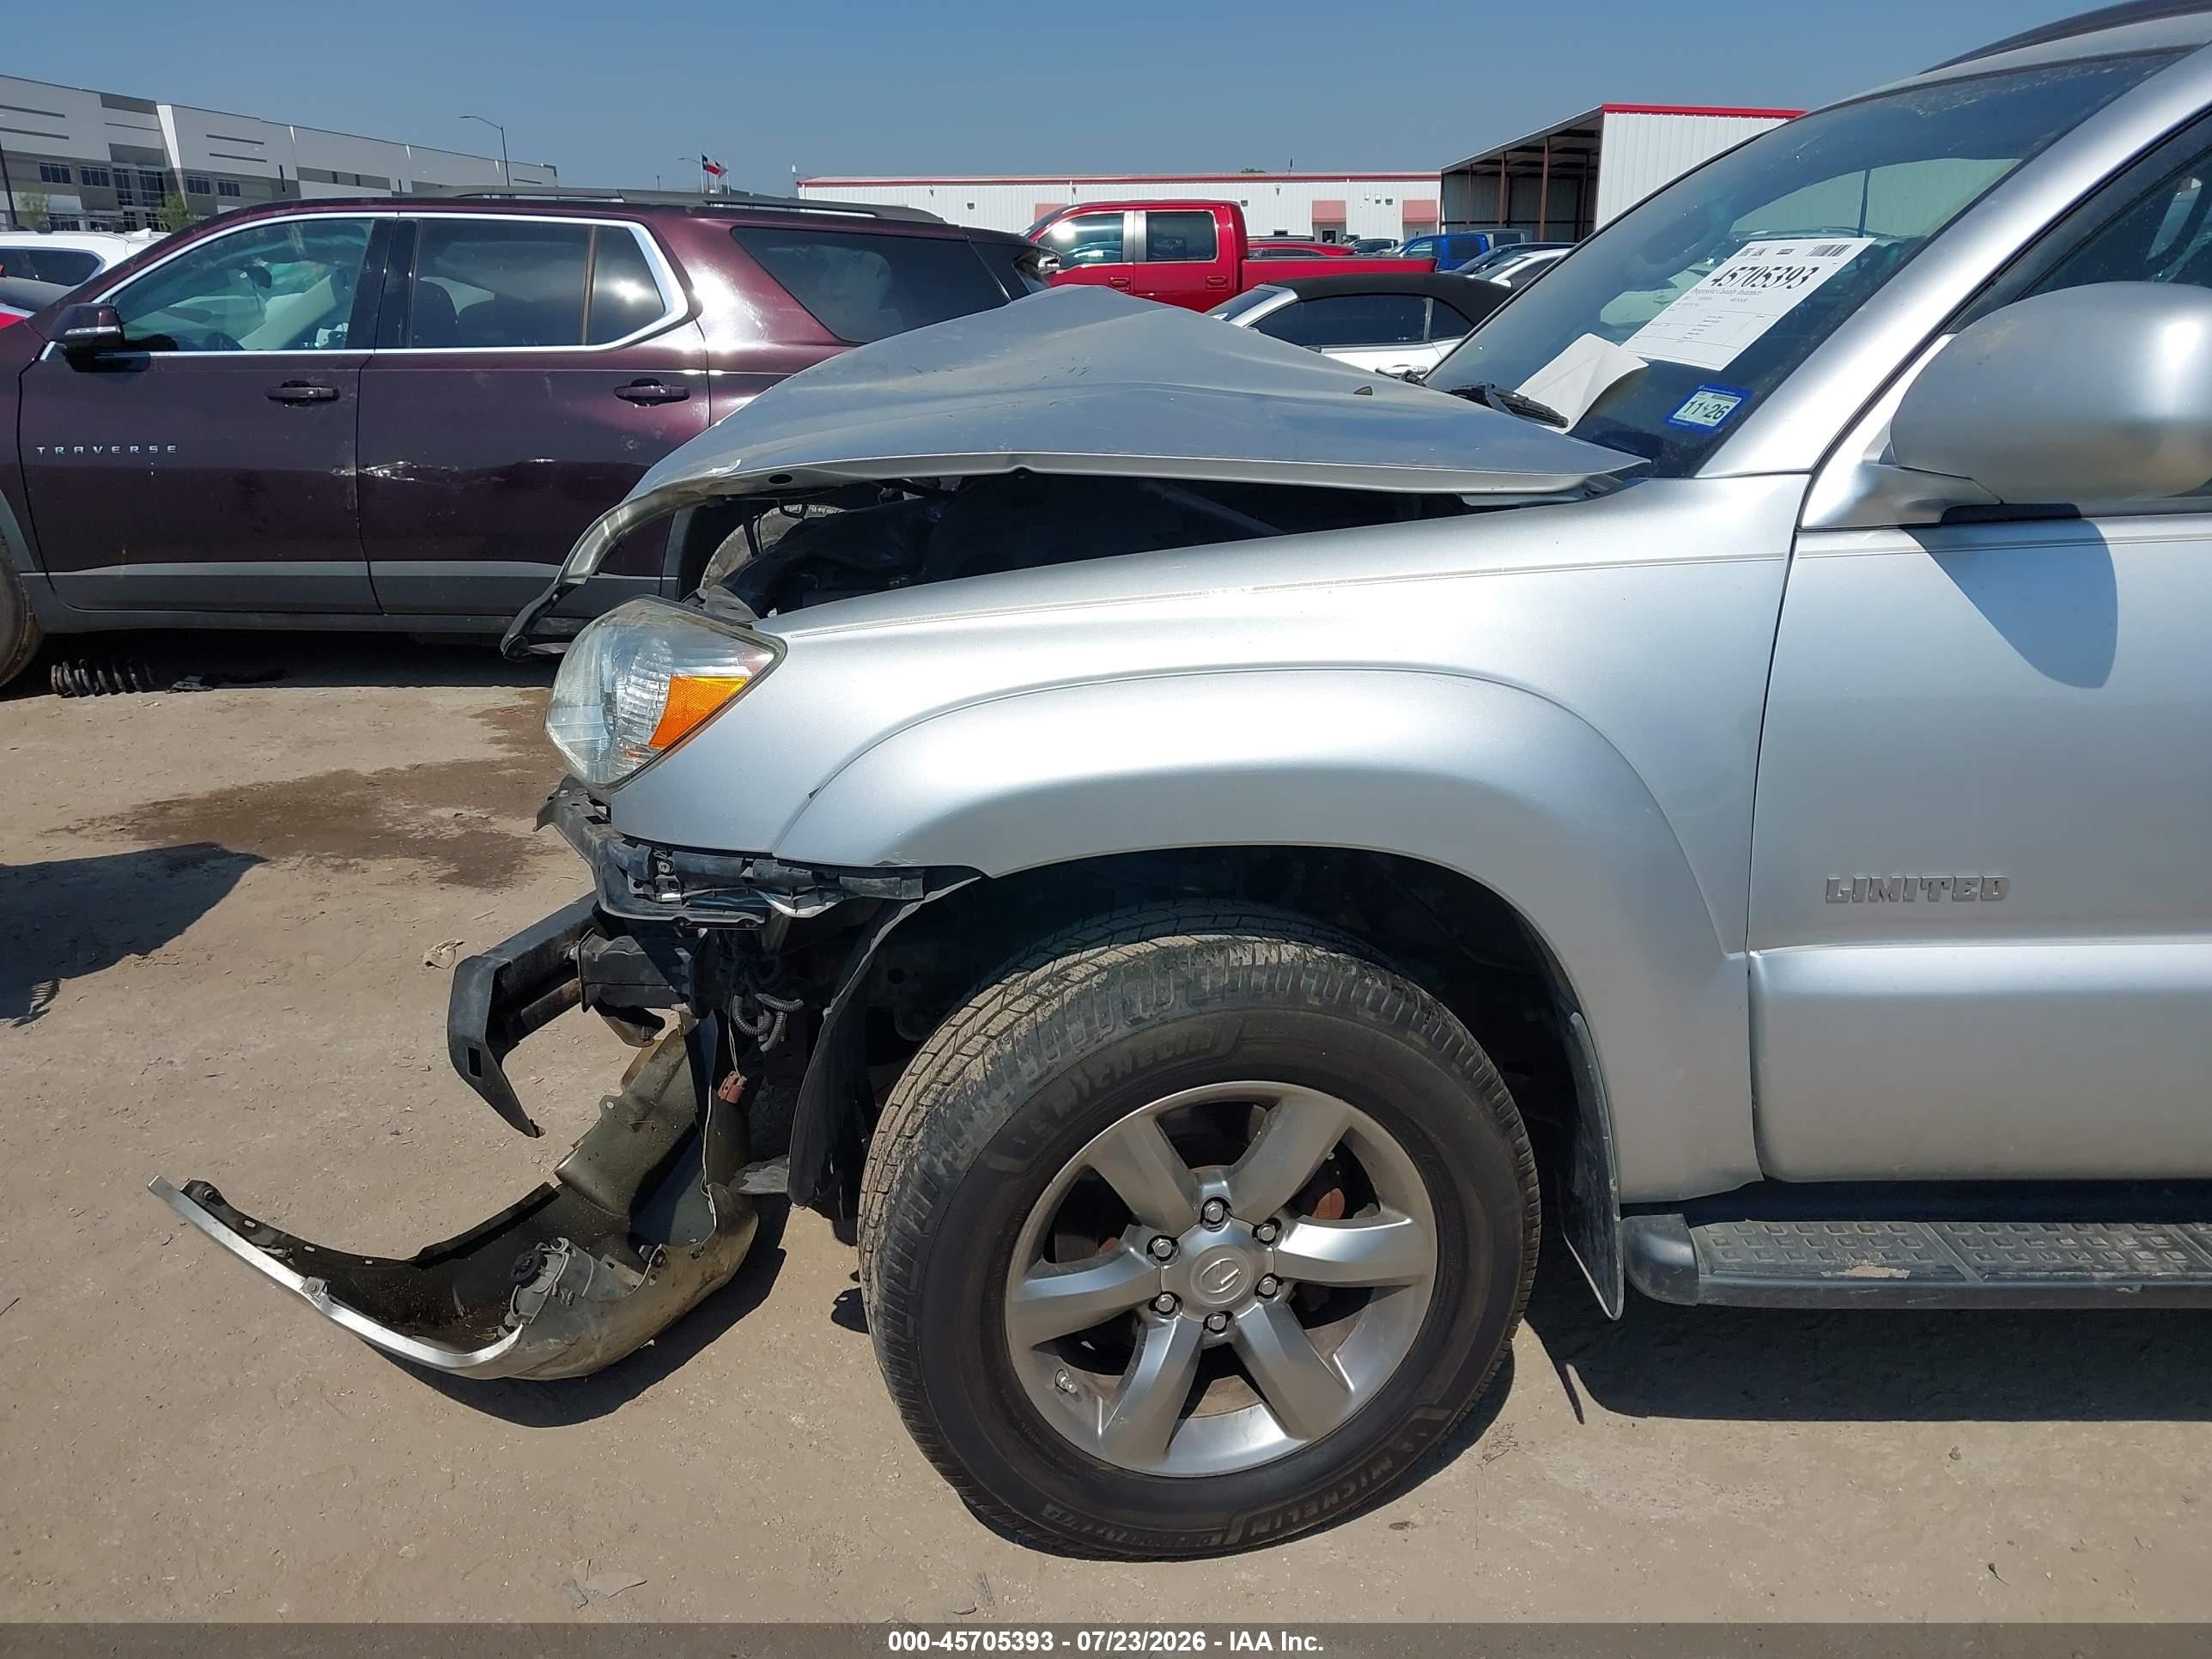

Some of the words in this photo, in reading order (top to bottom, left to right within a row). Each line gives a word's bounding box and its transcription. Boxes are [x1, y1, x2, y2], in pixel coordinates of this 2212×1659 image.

[1711, 265, 1820, 289] 45705393
[1683, 400, 1705, 416] 11
[1704, 404, 1729, 420] 26
[36, 445, 178, 455] TRAVERSE
[1826, 874, 2010, 903] LIMITED
[1249, 1456, 1395, 1537] MICHELIN
